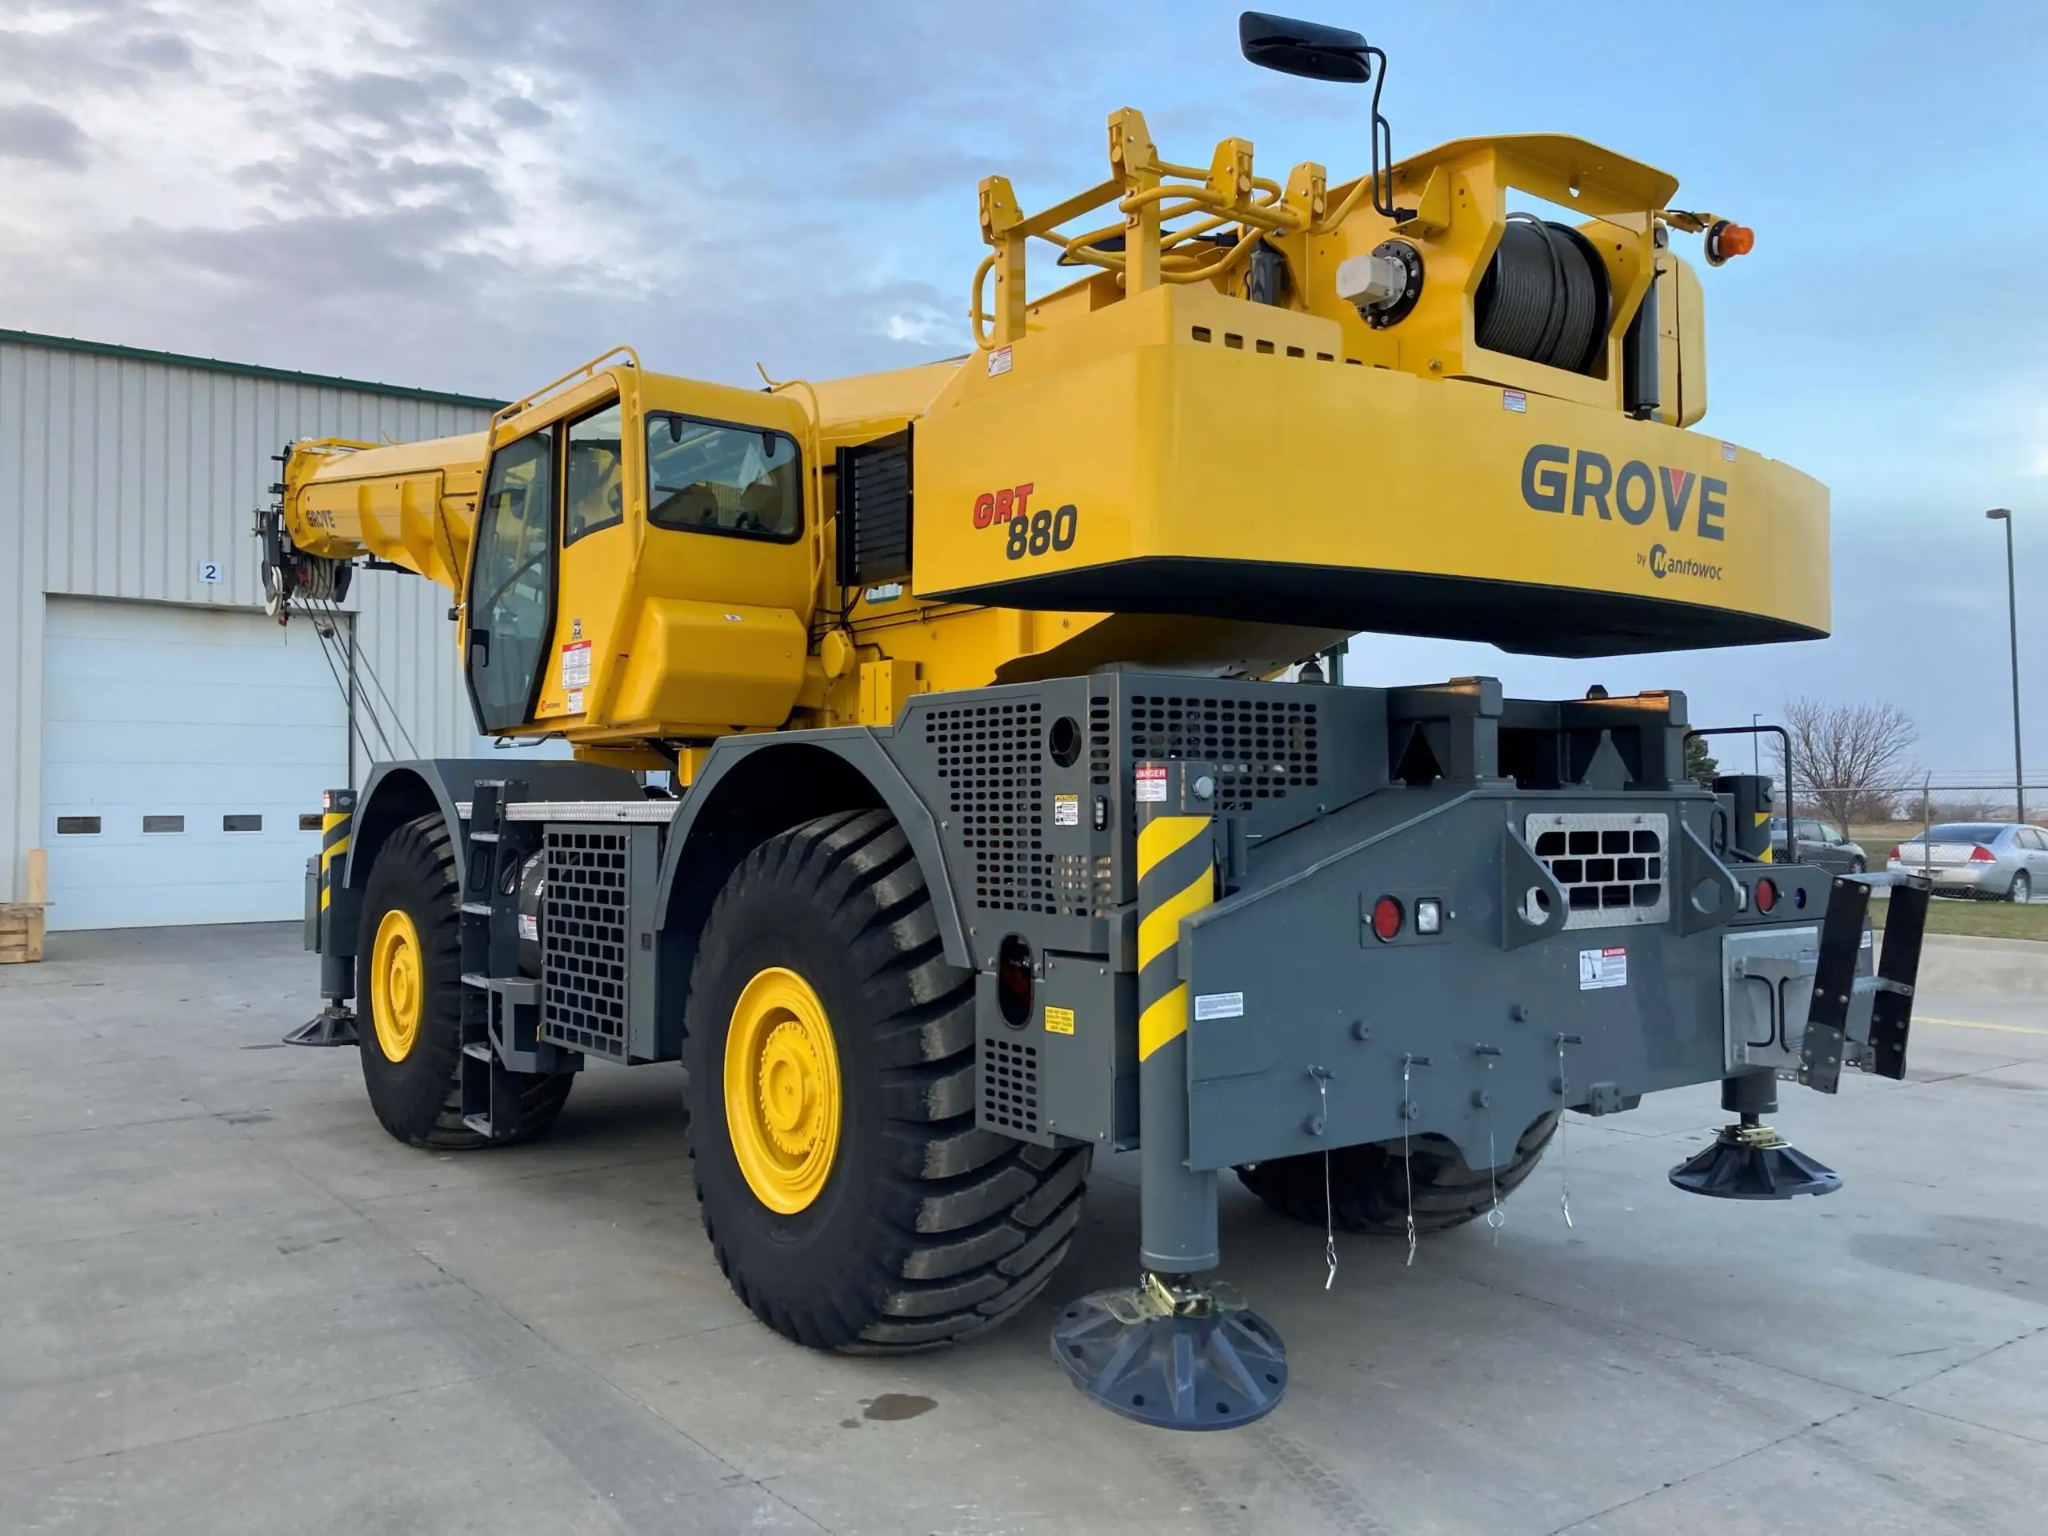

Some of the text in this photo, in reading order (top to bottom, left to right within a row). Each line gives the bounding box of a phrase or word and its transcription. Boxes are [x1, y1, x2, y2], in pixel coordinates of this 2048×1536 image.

[973, 482, 1034, 530] GRT
[1521, 443, 1727, 541] GROVE
[306, 509, 335, 528] GROVE
[1006, 504, 1077, 561] 880
[205, 565, 216, 579] 2
[1636, 543, 1722, 580] by Manitowoc
